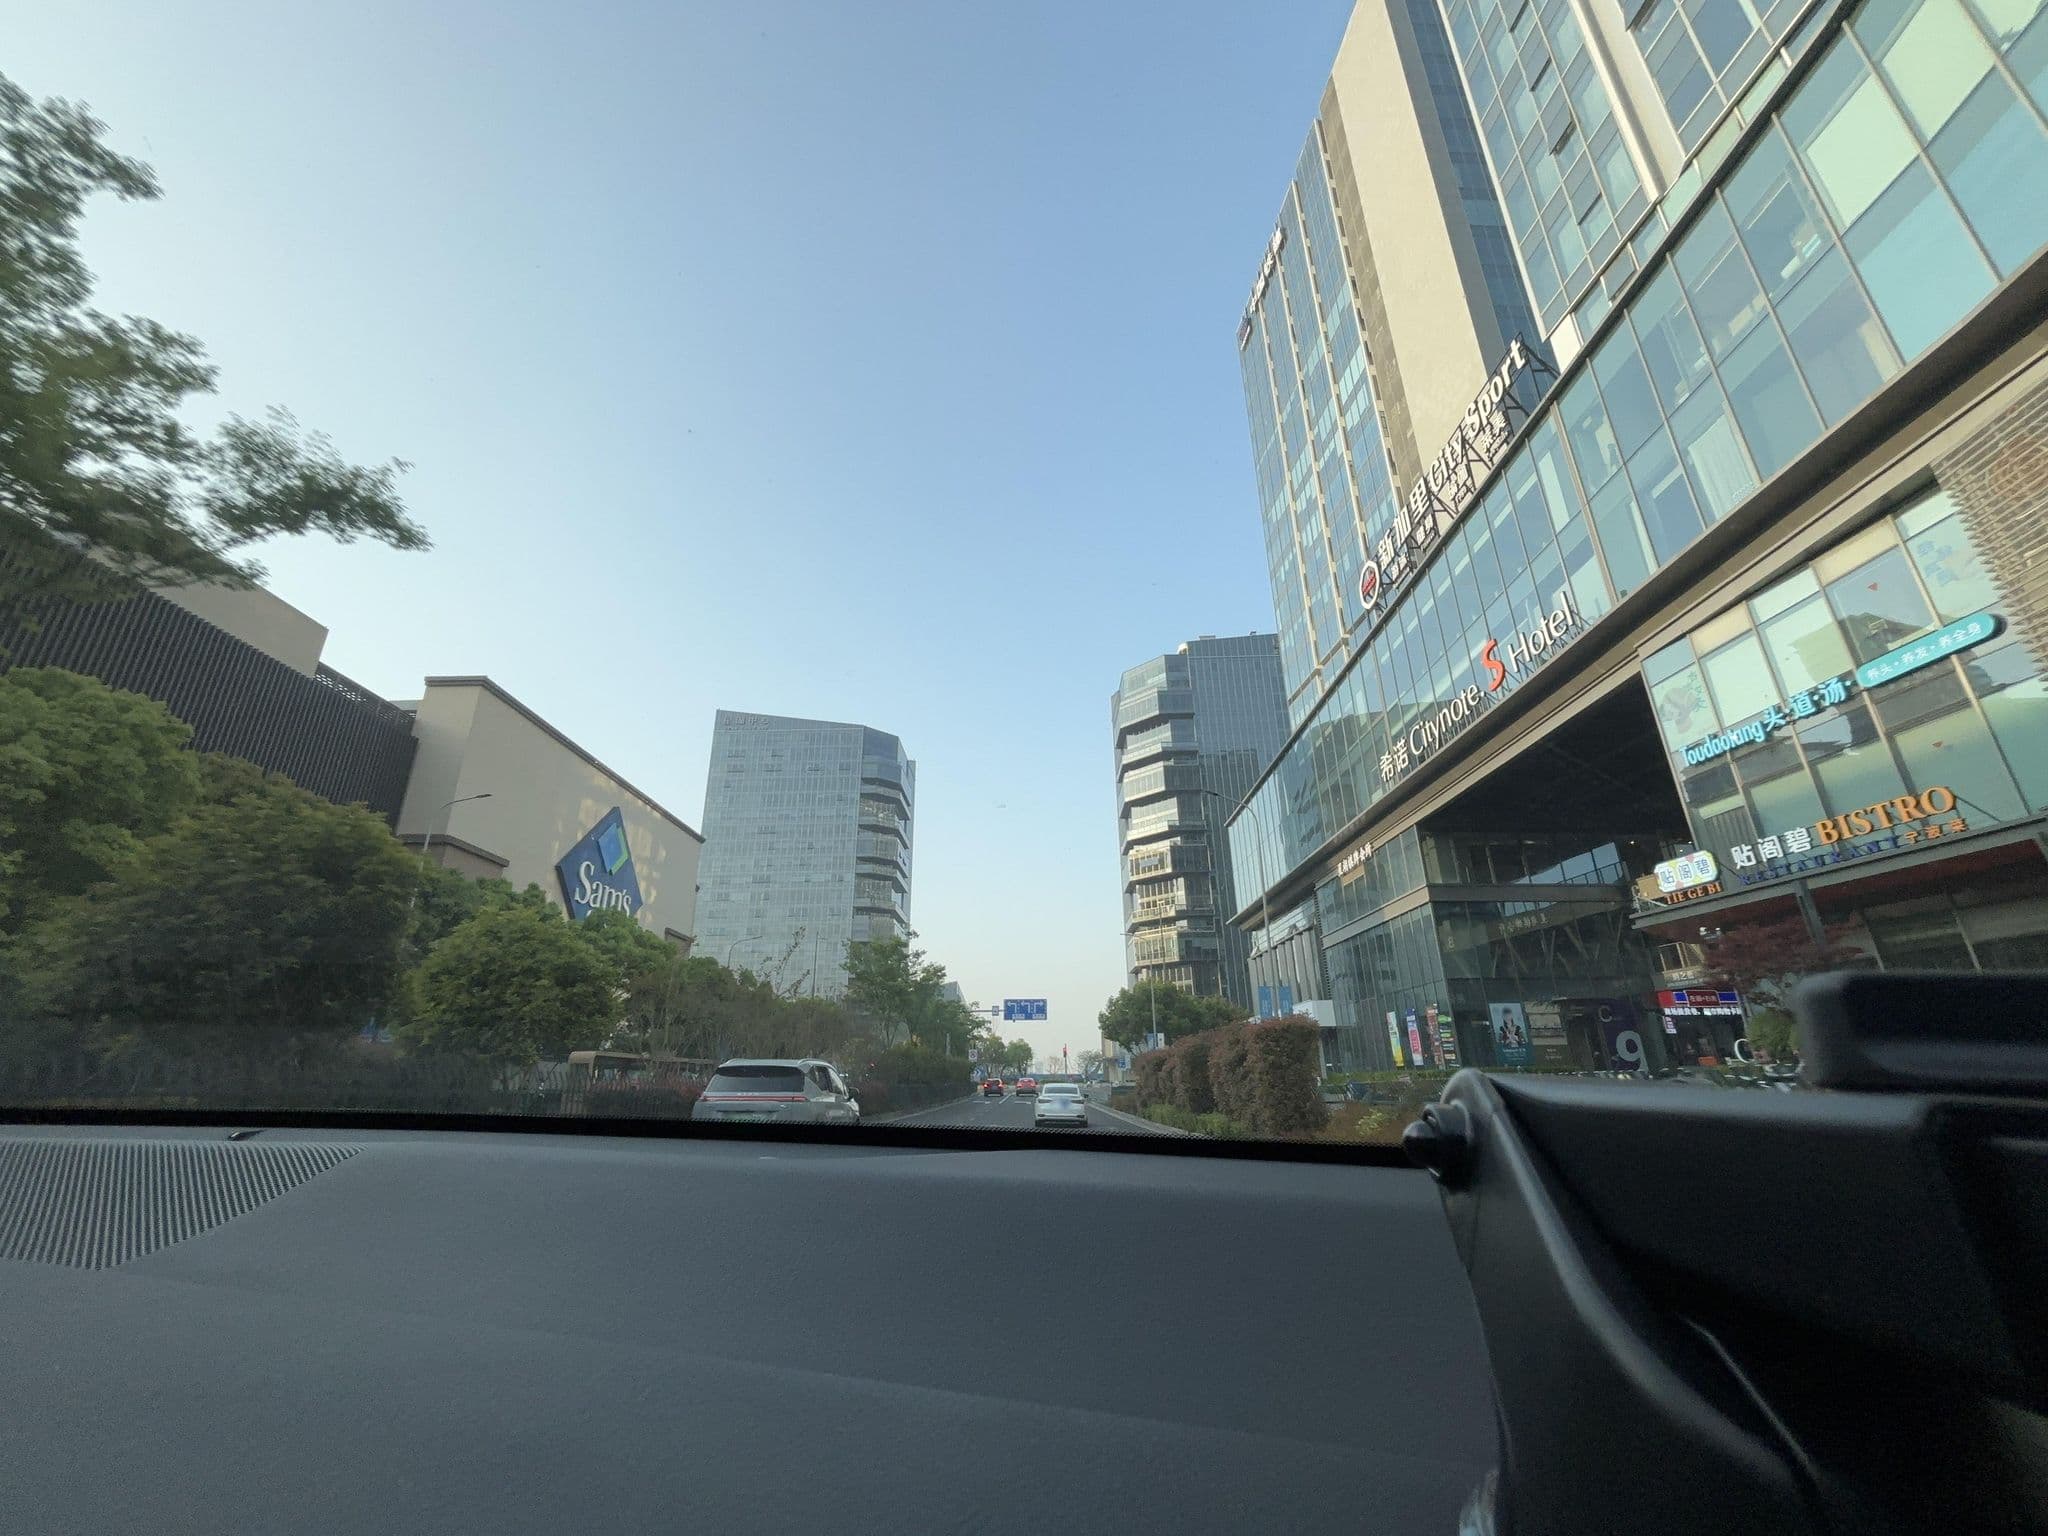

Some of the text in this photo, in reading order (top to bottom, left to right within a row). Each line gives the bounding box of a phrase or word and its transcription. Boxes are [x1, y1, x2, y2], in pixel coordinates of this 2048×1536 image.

[1429, 430, 1469, 490] City
[1464, 339, 1527, 435] Sport
[1380, 736, 1409, 782] 希诺
[1481, 638, 1505, 692] S
[1507, 590, 1575, 673] Hotel
[1730, 785, 1957, 870] 贴阁碧 BISTRO
[574, 860, 632, 917] Sam's
[1659, 858, 1711, 884] 贴阁碧
[1665, 880, 1722, 905] TIE GE BI
